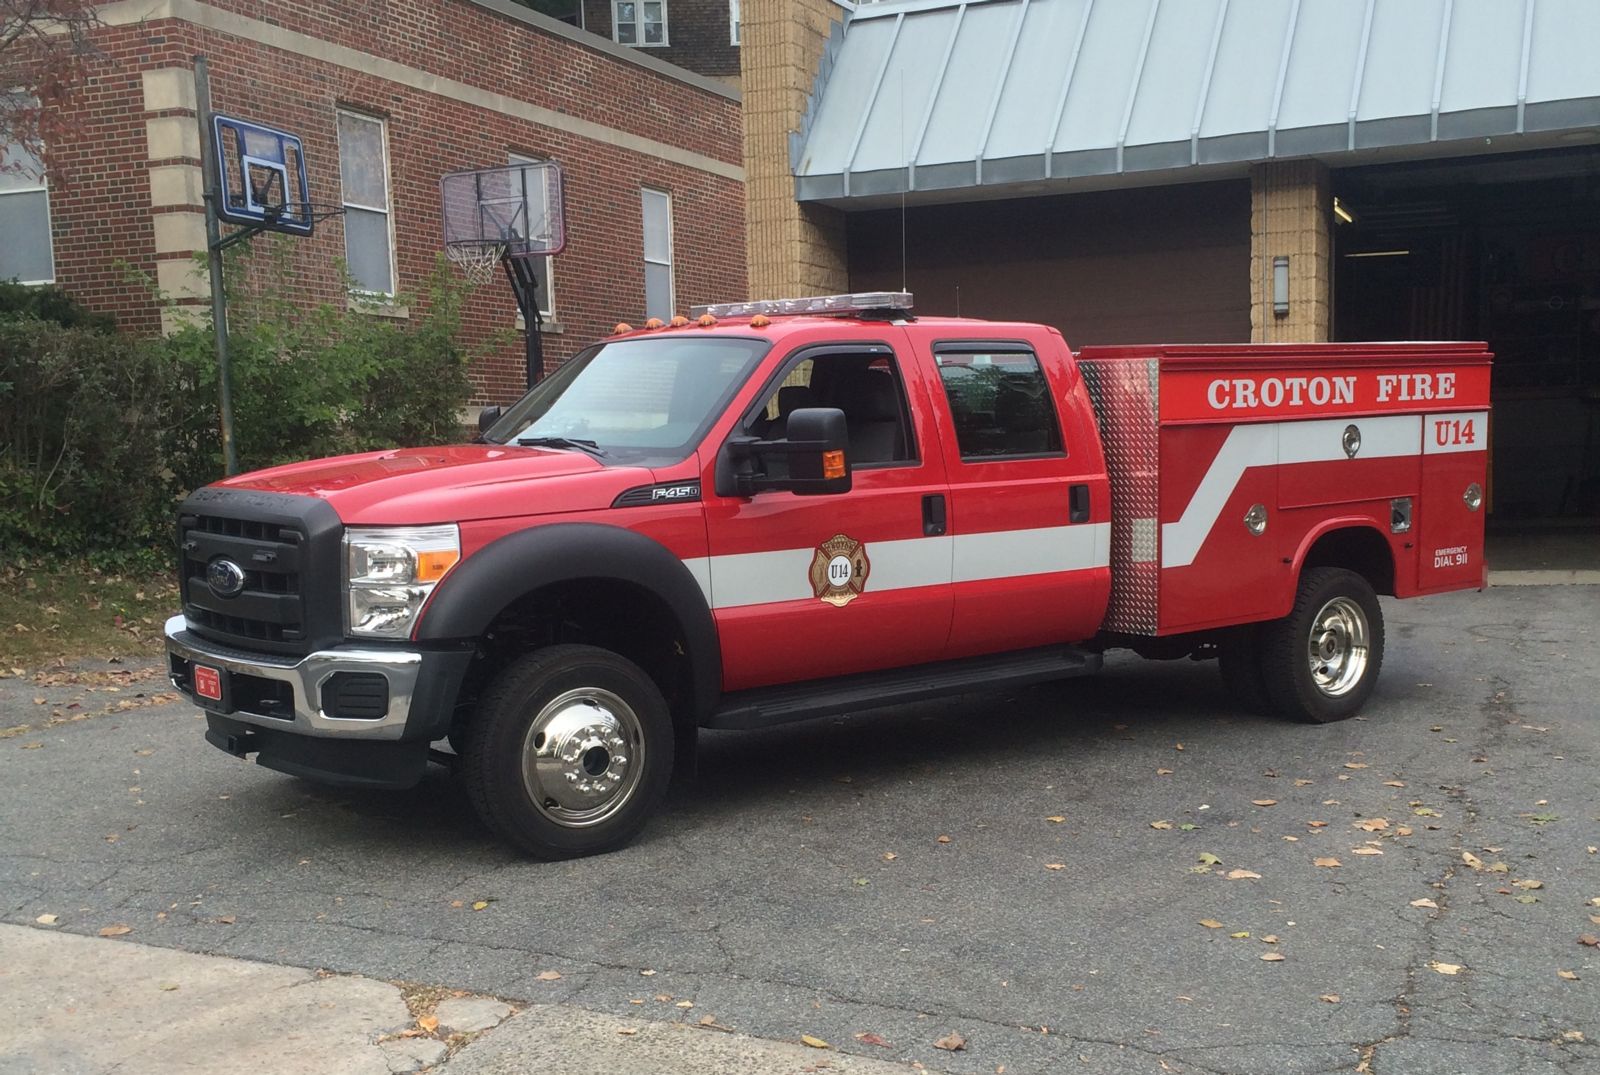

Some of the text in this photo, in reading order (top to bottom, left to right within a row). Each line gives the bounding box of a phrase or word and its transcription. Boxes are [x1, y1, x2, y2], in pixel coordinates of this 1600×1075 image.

[1207, 372, 1456, 410] CROTON FIRE
[1435, 419, 1475, 446] U14
[1435, 545, 1468, 557] EMERGENCY
[1434, 553, 1468, 568] DIAL 911
[831, 564, 848, 579] U14
